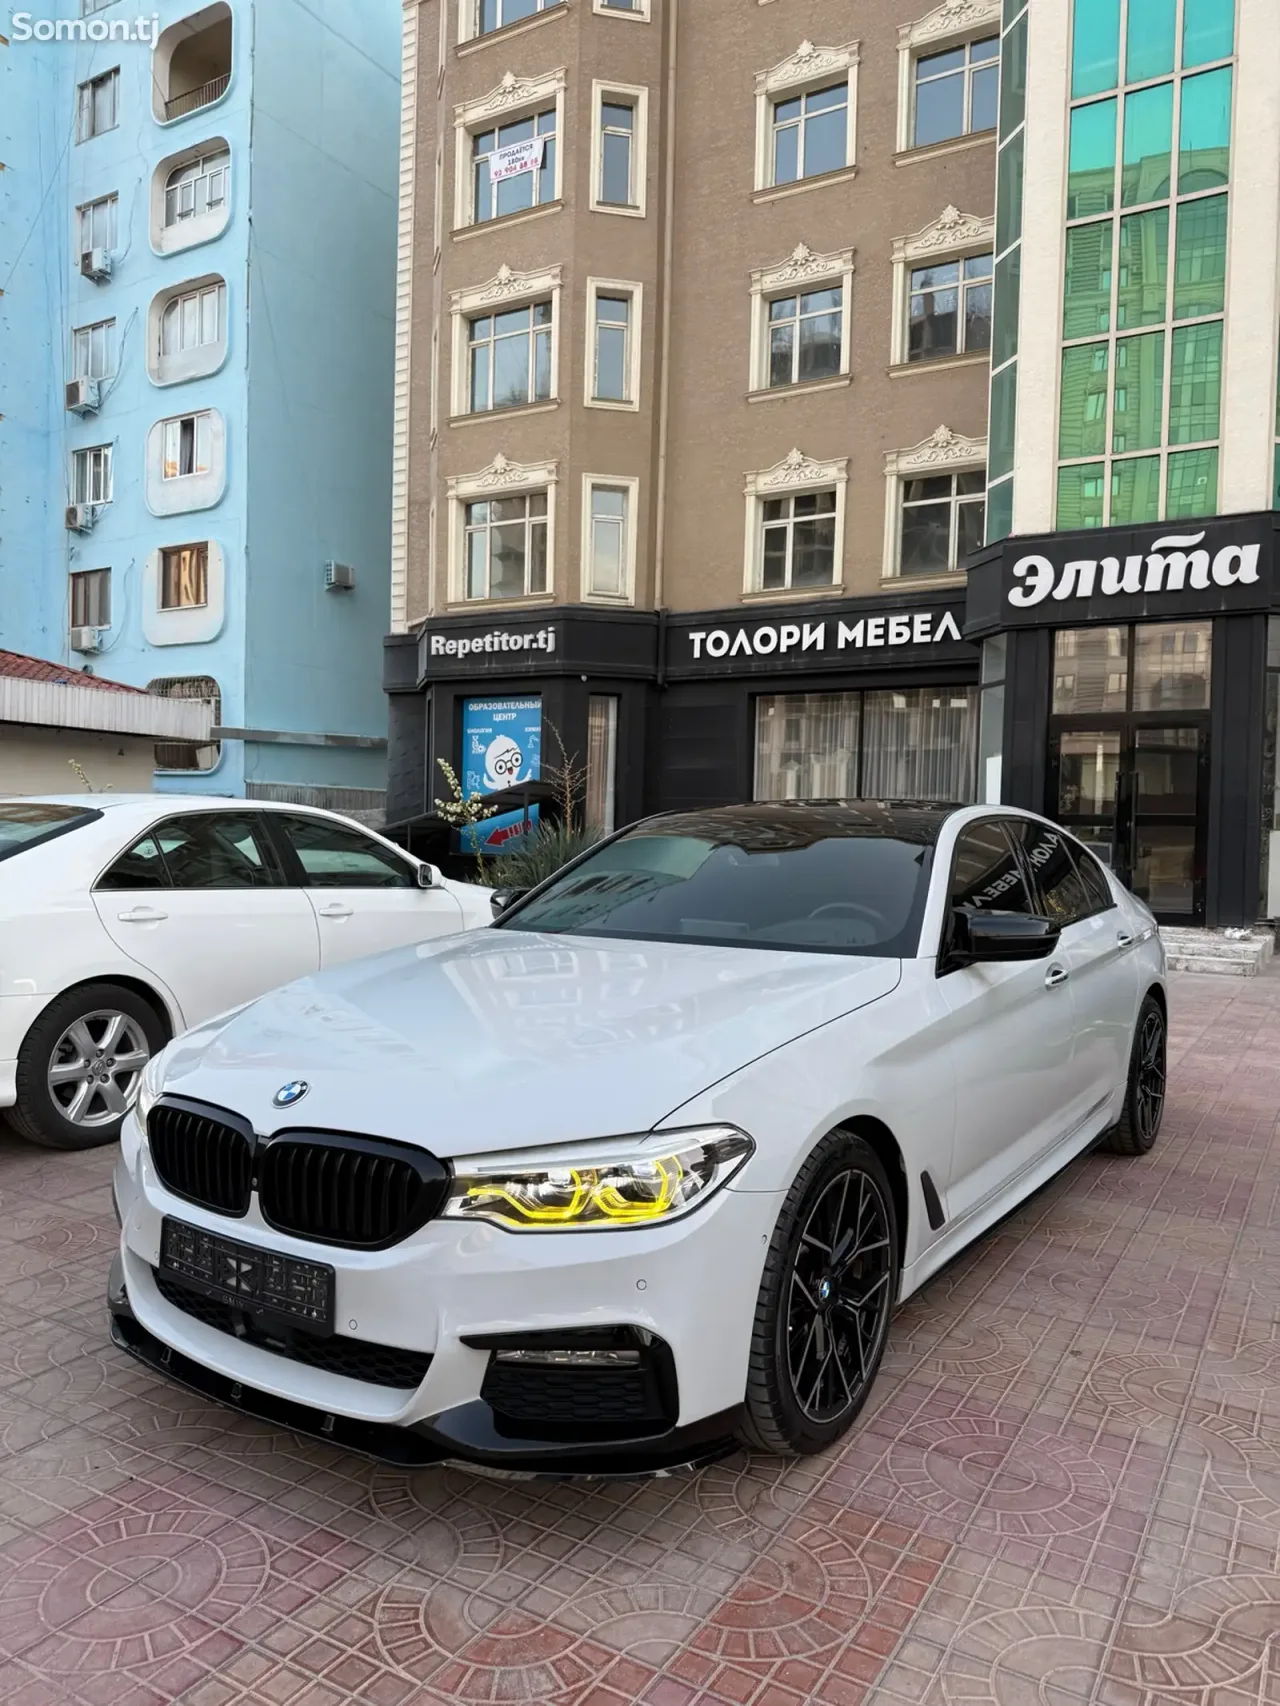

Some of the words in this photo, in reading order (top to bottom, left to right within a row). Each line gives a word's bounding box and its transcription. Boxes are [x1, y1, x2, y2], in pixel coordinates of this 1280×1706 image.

[1007, 530, 1261, 608] Элита
[431, 626, 556, 658] Repetitor.tj
[689, 621, 825, 659] ТОЛОРИ
[837, 611, 962, 649] МЕБЕЛ
[468, 700, 542, 711] ОБРАЗОВАТЕЛЬНЫЙ
[493, 712, 517, 722] ЦЕНТР
